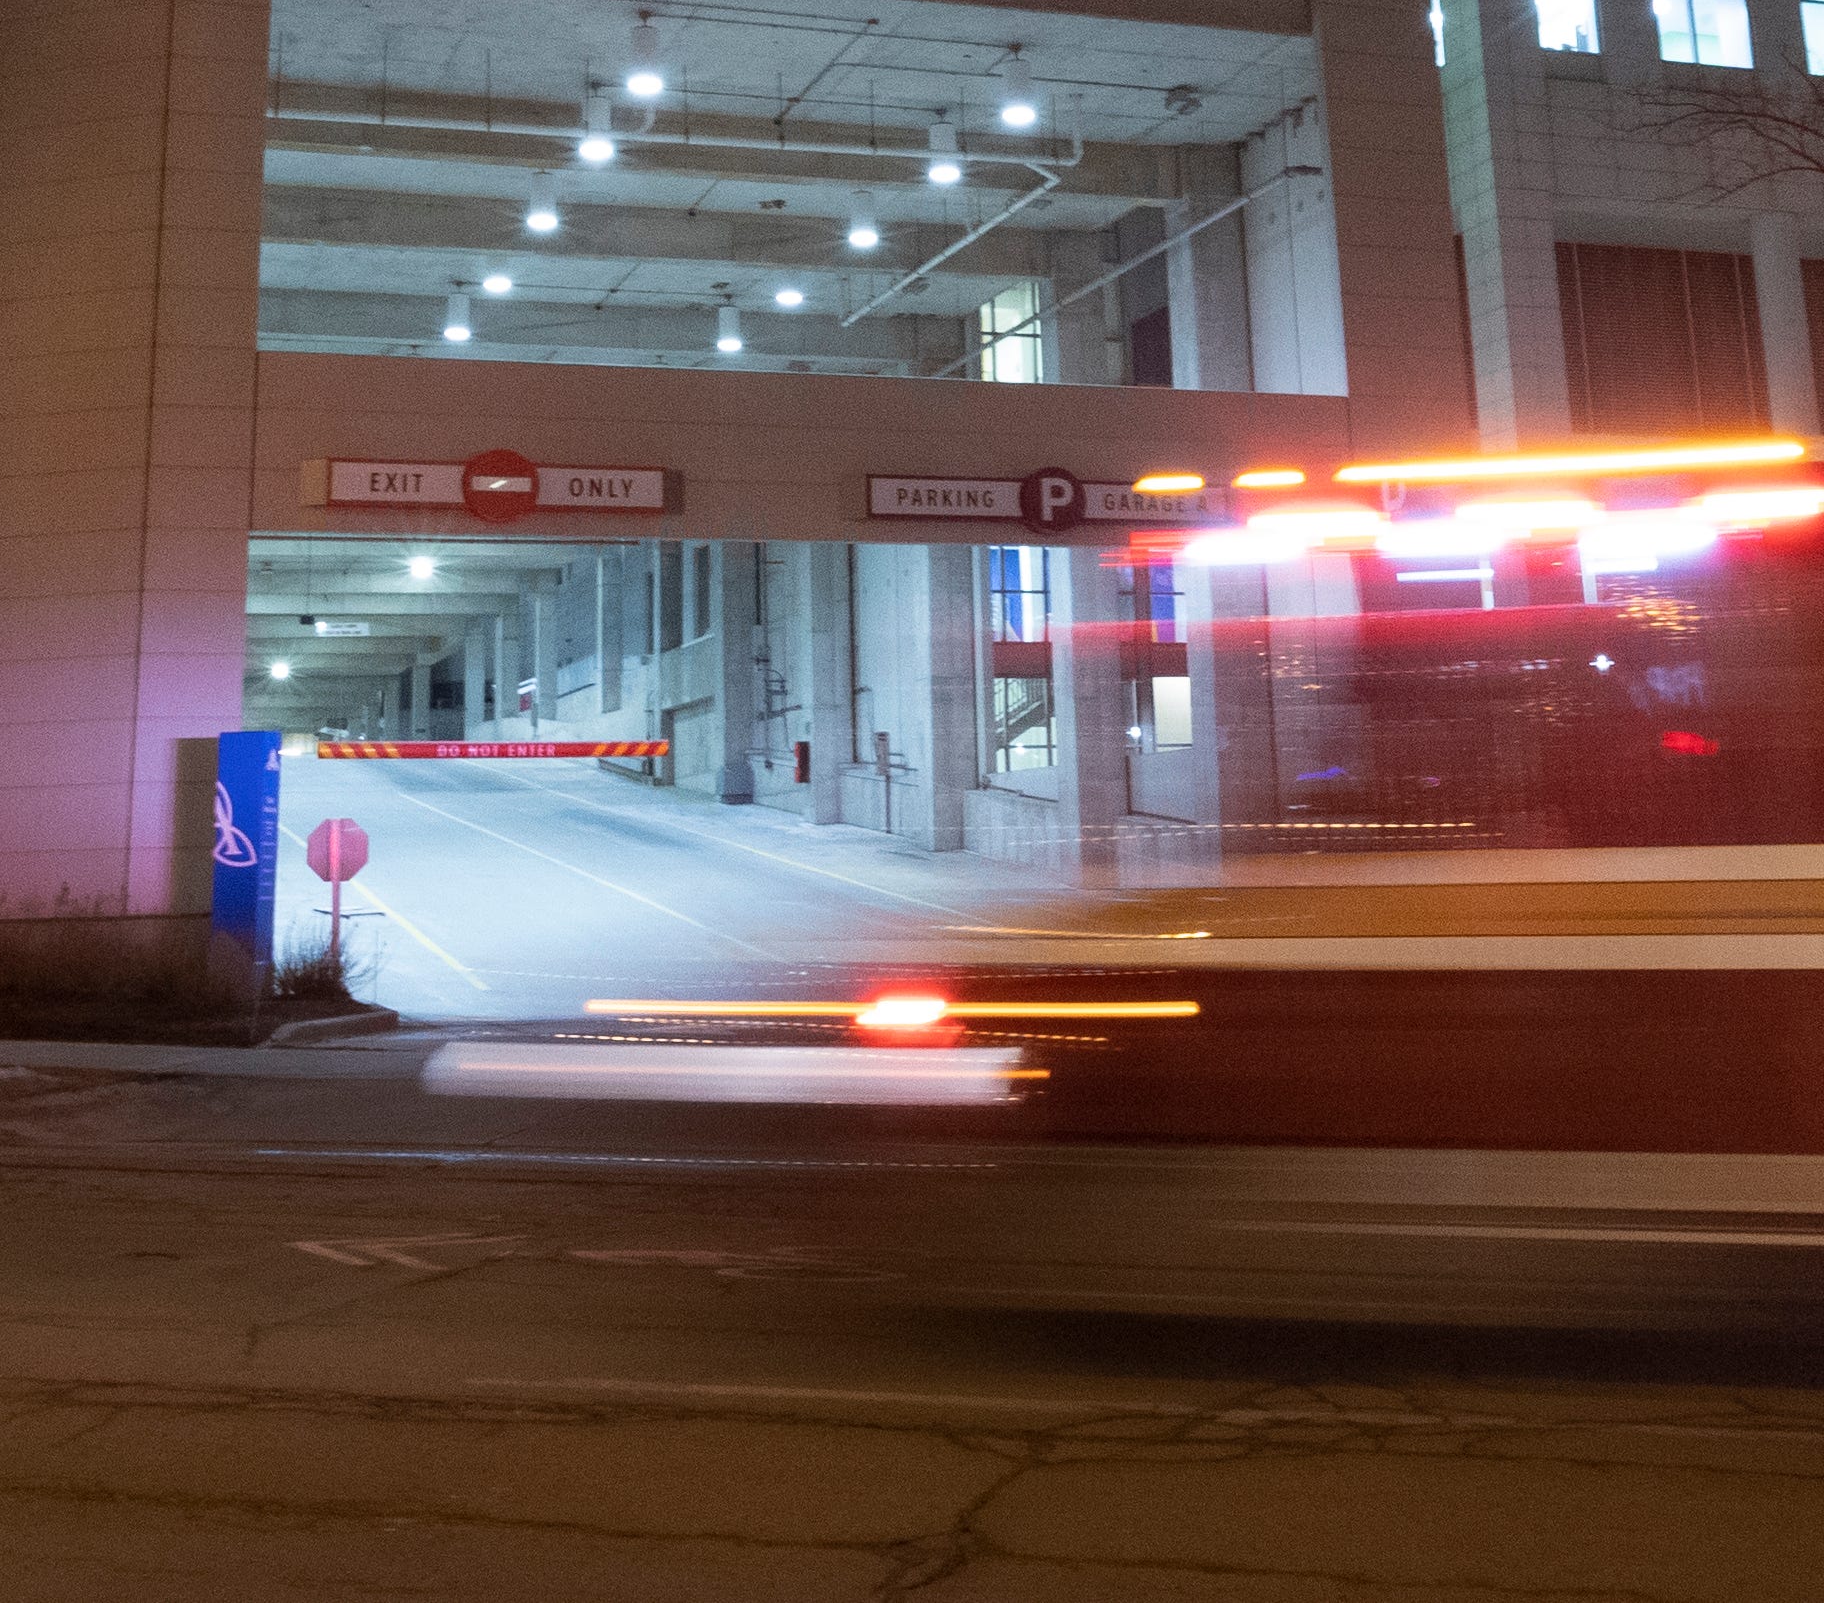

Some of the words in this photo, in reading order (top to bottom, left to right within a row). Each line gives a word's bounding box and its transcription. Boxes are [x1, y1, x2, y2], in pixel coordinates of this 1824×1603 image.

[370, 472, 423, 494] EXIT
[569, 477, 634, 498] ONLY
[897, 488, 995, 509] PARKING
[1040, 477, 1072, 522] P
[1104, 492, 1186, 514] GARAGE
[436, 744, 460, 757] DO
[468, 744, 499, 757] NOT
[508, 744, 555, 757] ENTER
